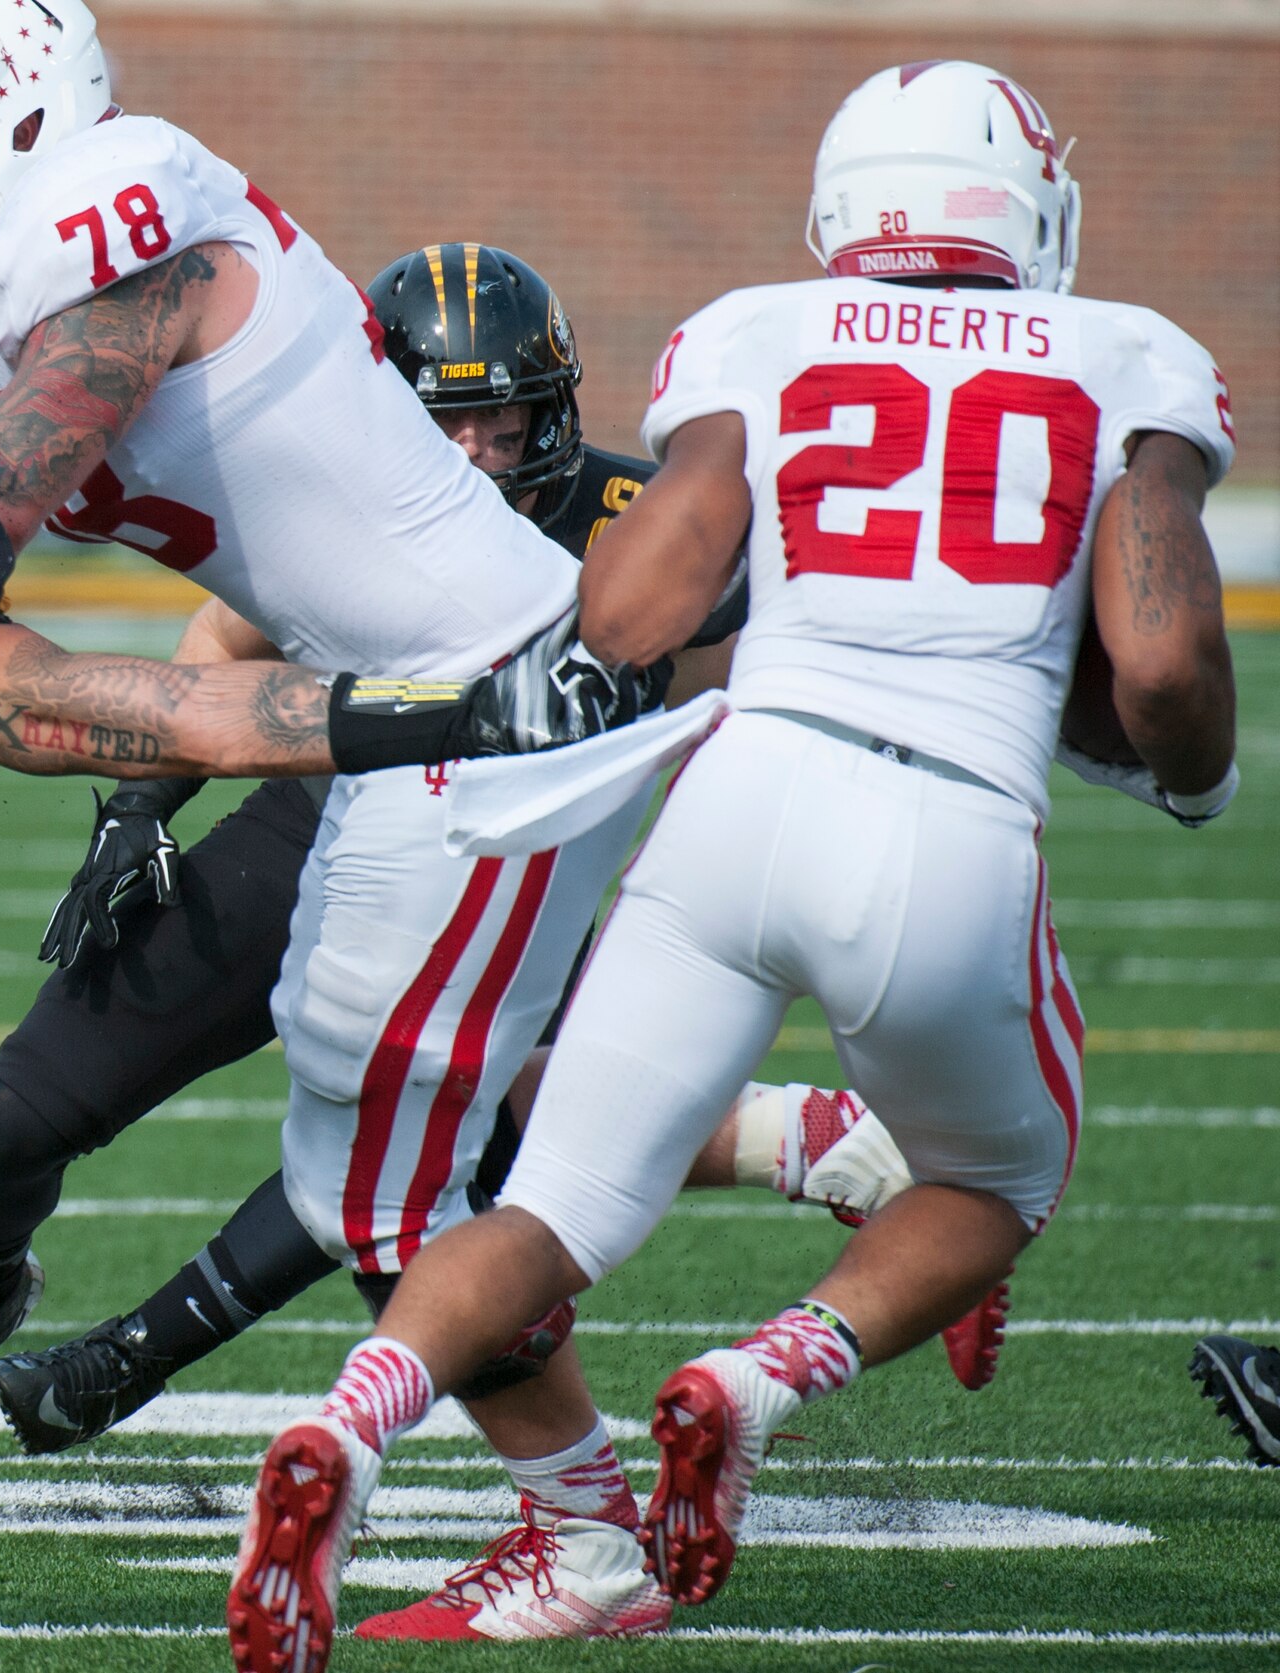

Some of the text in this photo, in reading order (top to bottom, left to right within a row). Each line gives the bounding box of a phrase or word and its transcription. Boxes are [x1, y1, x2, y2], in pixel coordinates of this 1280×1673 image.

[55, 183, 172, 289] 78
[880, 210, 908, 237] 20
[858, 250, 940, 273] INDIANA
[832, 303, 1050, 358] ROBERTS
[441, 362, 486, 379] TIGERS
[776, 363, 1101, 589] 20
